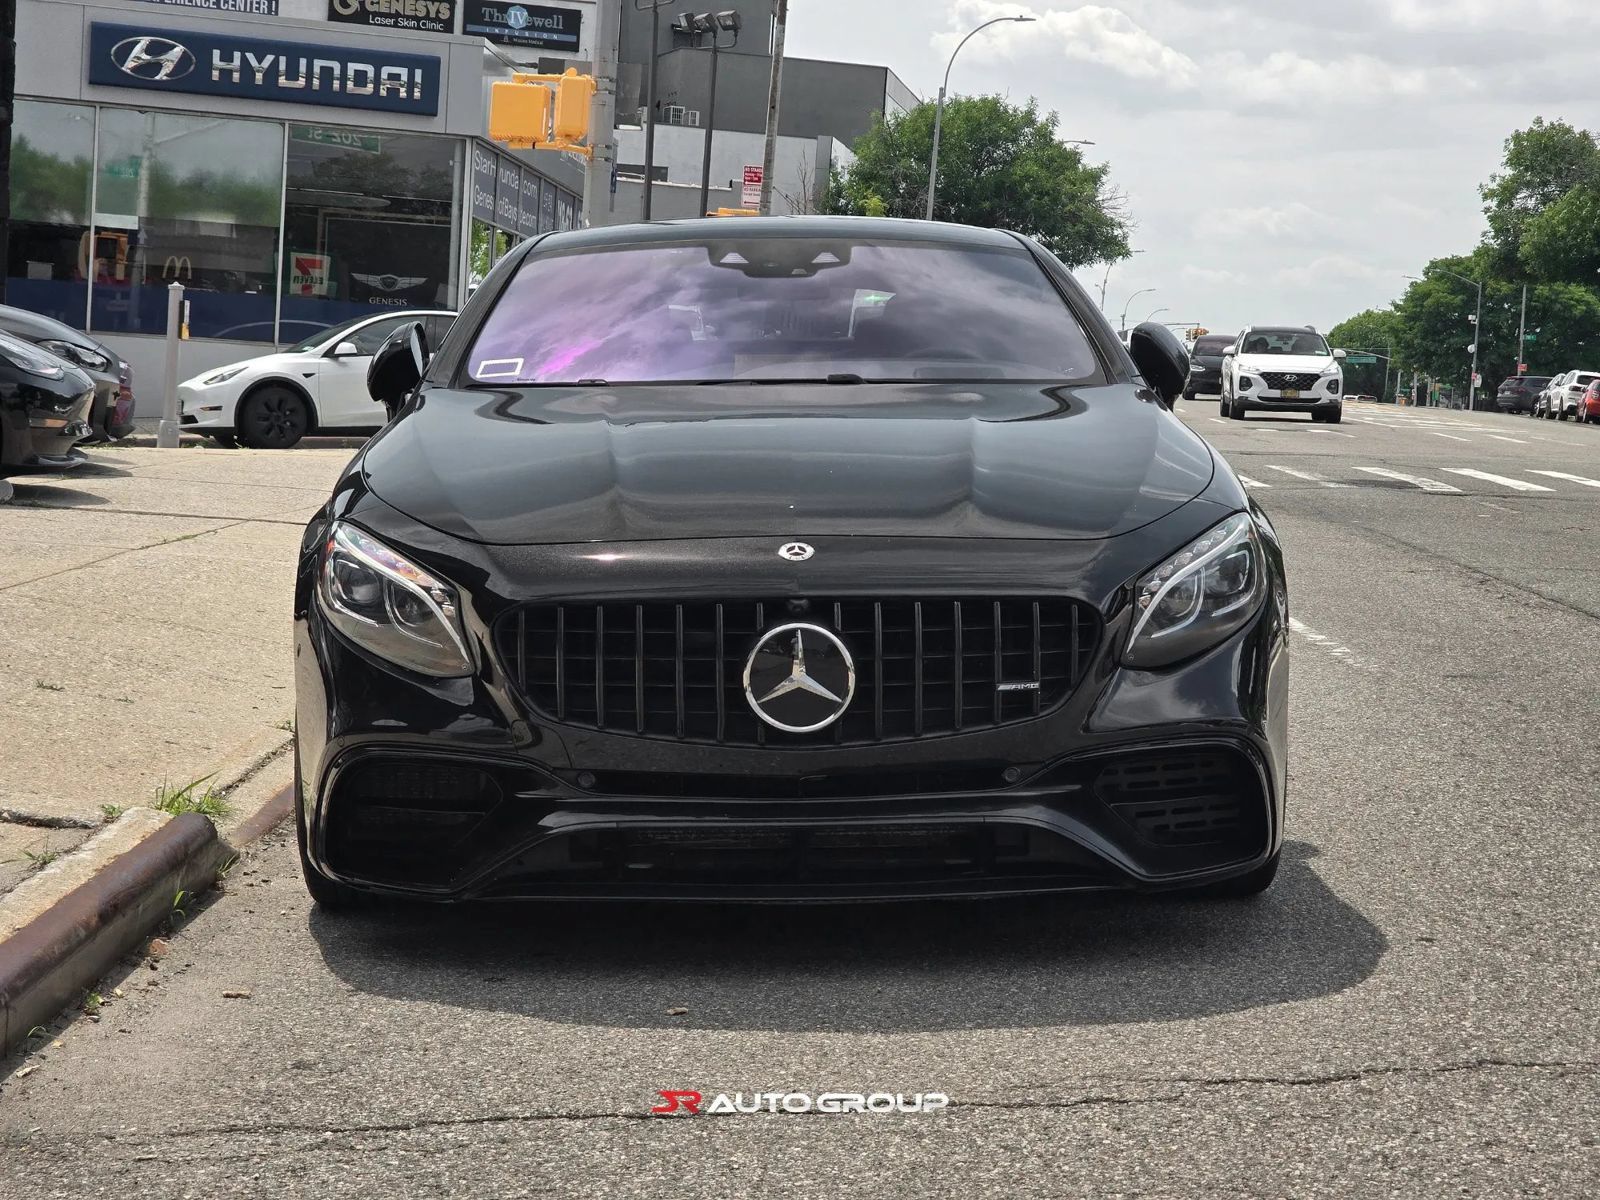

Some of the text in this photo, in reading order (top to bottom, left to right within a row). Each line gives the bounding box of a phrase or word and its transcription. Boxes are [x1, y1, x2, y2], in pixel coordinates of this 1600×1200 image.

[220, 0, 268, 14] CENTER
[365, 0, 451, 20] GENESYS
[369, 14, 445, 31] Laser Skin Clinic
[486, 28, 559, 40] INFUSION
[211, 48, 423, 101] HYUNDAI
[368, 296, 408, 307] GENESIS
